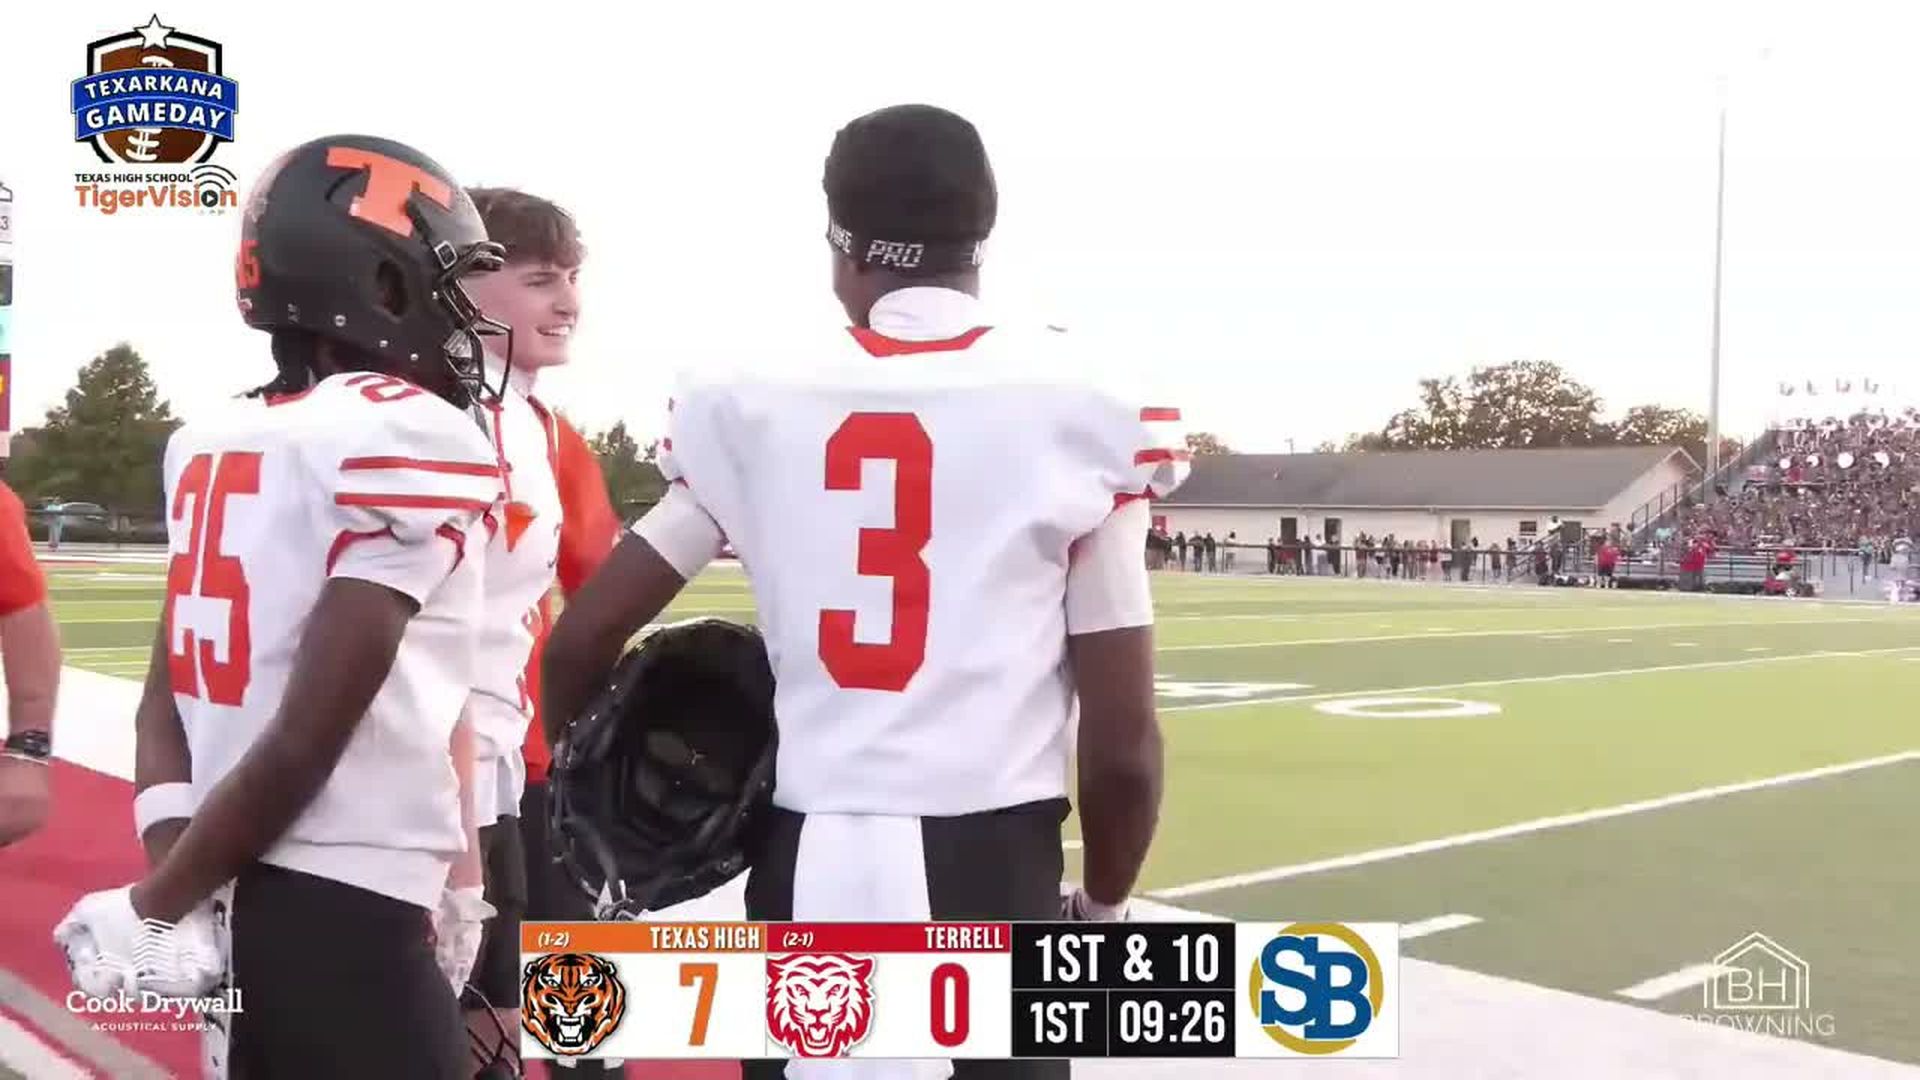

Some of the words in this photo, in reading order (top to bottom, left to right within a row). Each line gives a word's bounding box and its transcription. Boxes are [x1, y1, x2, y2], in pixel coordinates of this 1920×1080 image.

[326, 147, 453, 238] T
[866, 239, 924, 268] PRO
[167, 451, 264, 707] 25
[817, 411, 933, 692] 3
